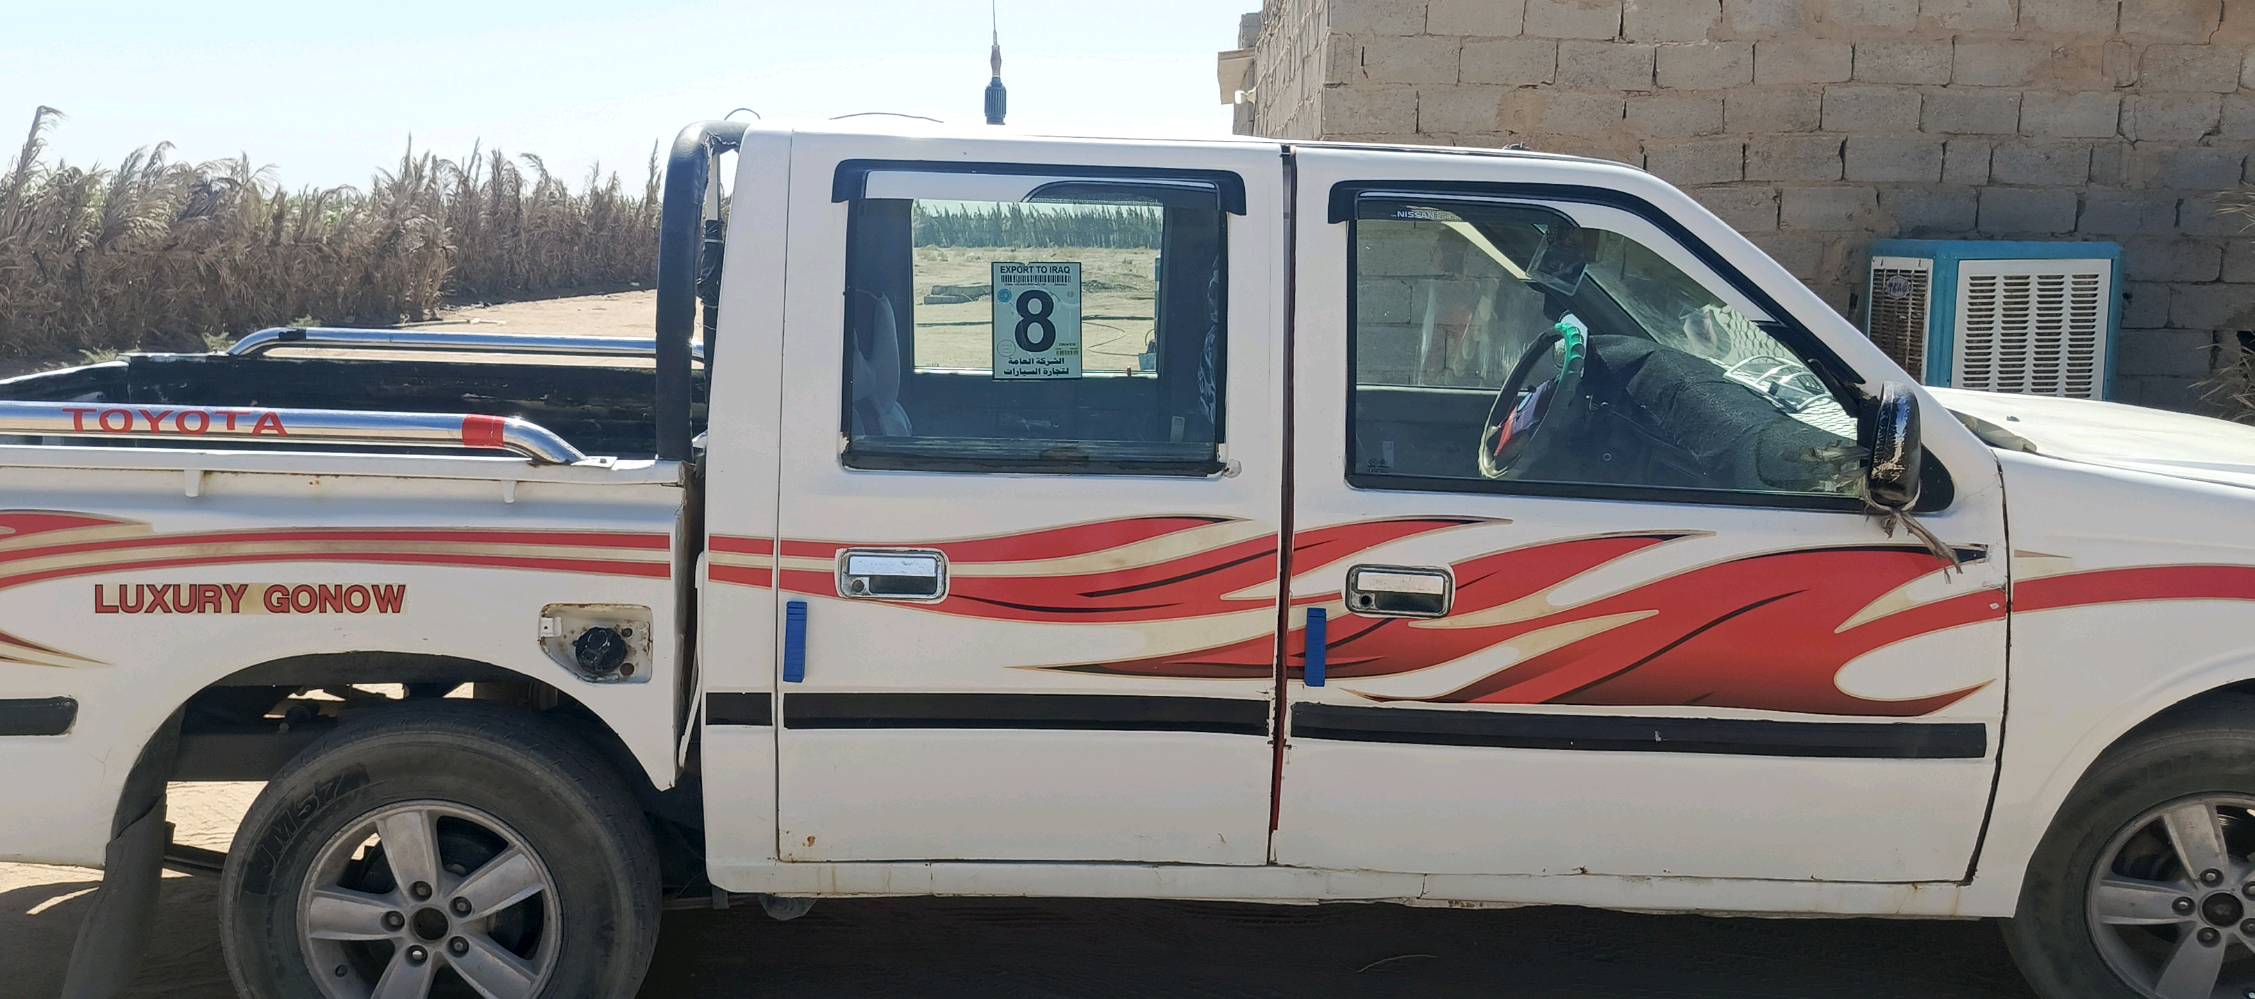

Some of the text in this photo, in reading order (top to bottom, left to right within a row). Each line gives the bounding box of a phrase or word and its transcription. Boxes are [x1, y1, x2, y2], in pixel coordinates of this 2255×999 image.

[1397, 210, 1435, 219] NISSAN
[1000, 265, 1071, 274] EXPORT TO IRAQ
[1014, 289, 1056, 353] 8
[1008, 357, 1065, 366] الشركة العامة
[1003, 367, 1069, 376] لتجارة السيارات
[62, 407, 288, 437] TOYOTA
[94, 583, 406, 614] LUXURY GONOW
